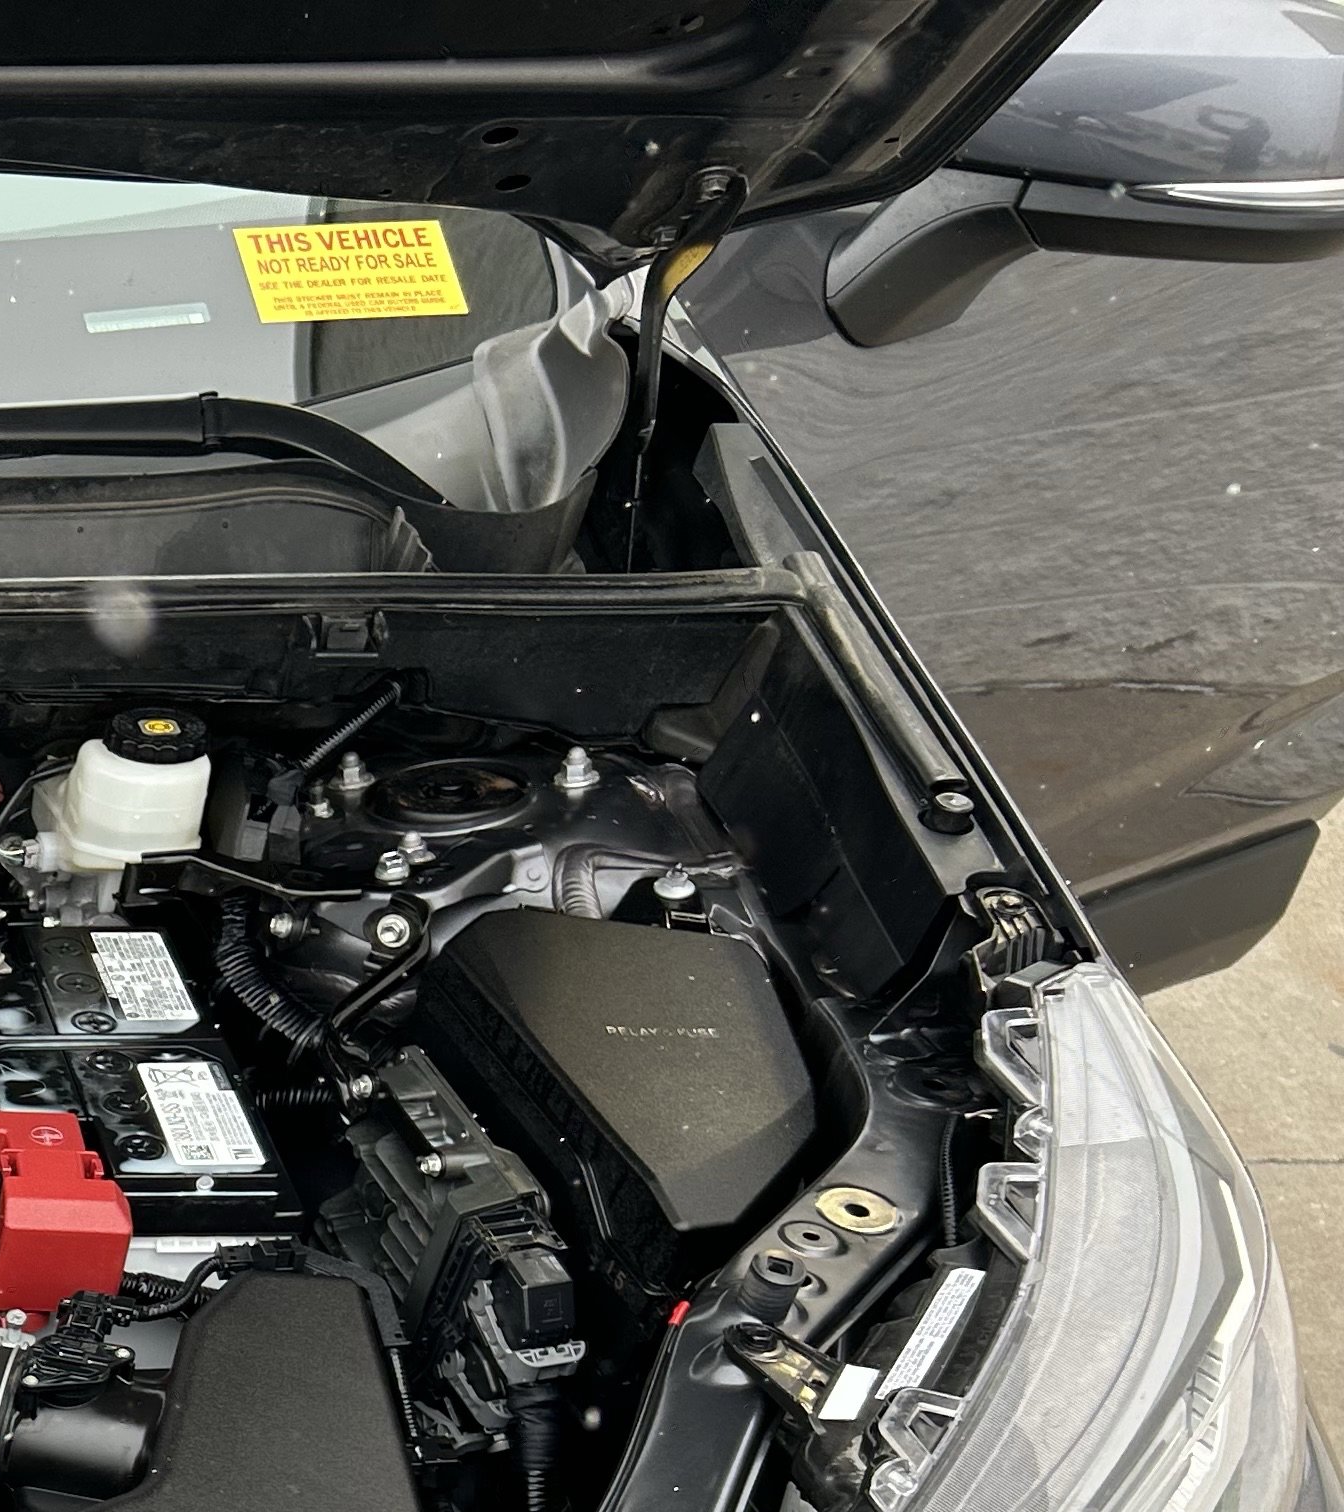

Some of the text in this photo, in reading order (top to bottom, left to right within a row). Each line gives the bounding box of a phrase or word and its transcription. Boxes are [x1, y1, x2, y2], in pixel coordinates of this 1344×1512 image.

[247, 228, 432, 254] THIS VEHICLE
[257, 252, 437, 275] NOT READY FOR SALE
[259, 274, 448, 291] SEE THE DEALER FOR RESALE DATE
[605, 1025, 658, 1038] RELAY
